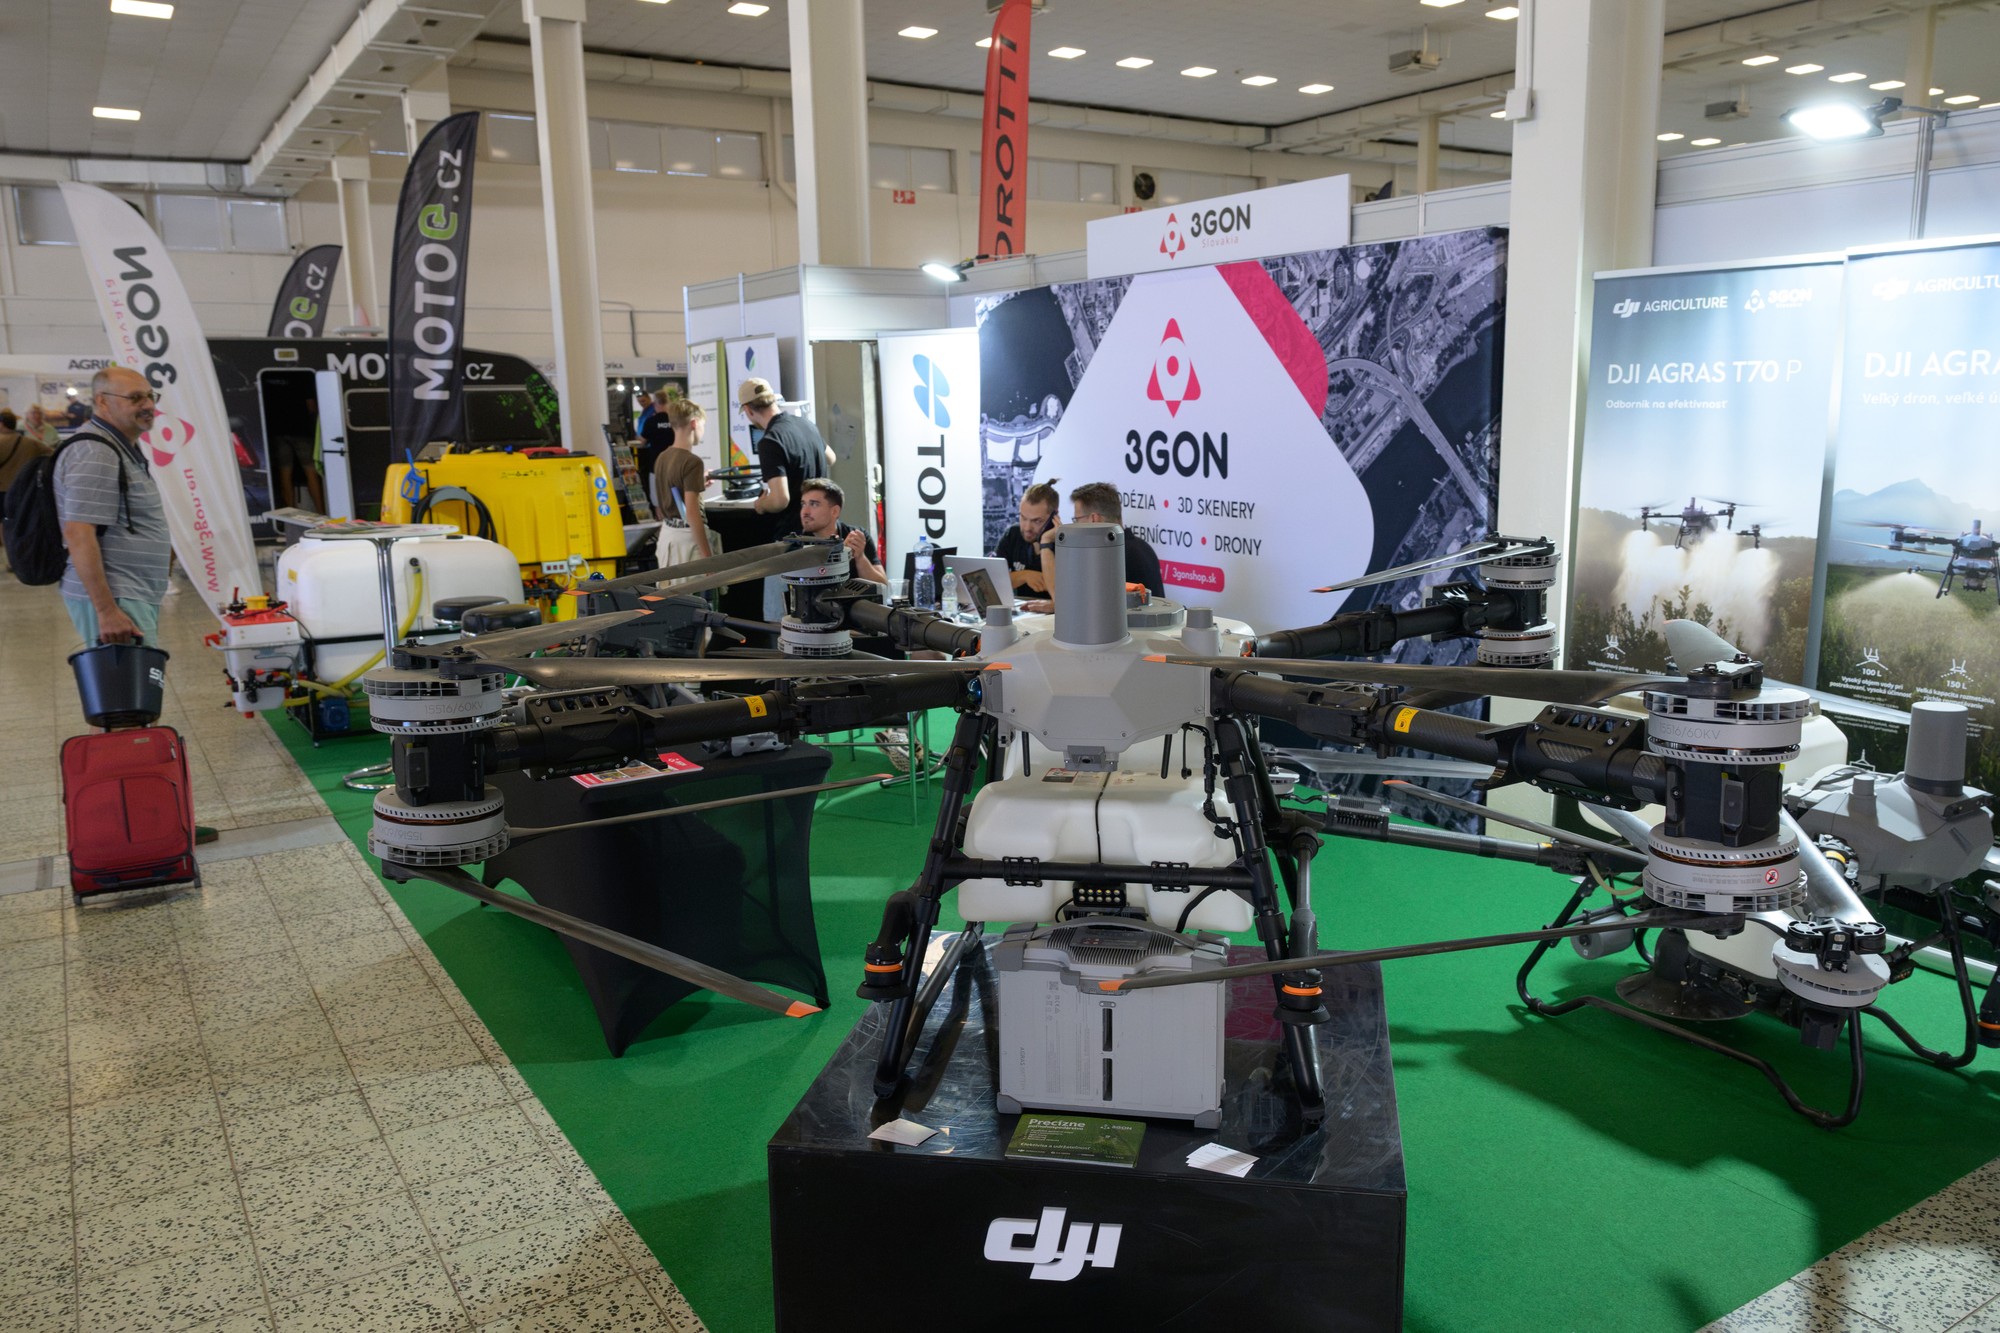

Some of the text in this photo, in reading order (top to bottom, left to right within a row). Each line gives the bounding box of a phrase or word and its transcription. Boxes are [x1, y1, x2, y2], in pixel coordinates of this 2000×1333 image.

[1191, 203, 1251, 238] 3GON
[1644, 296, 1728, 312] AGRICULTURE
[1607, 359, 1803, 384] DJI AGRAS T70 P
[1864, 351, 1912, 378] DJI
[1652, 400, 1666, 409] na
[1903, 391, 1940, 406] dron,
[1125, 429, 1228, 479] 3GON
[917, 434, 947, 549] TOP
[1177, 496, 1193, 514] 3D
[1197, 498, 1256, 520] SKENERY
[1214, 535, 1262, 556] DRONY
[1172, 567, 1217, 585] 3gonshop.sk
[1862, 668, 1876, 676] 100
[1946, 680, 1967, 690] 150 L
